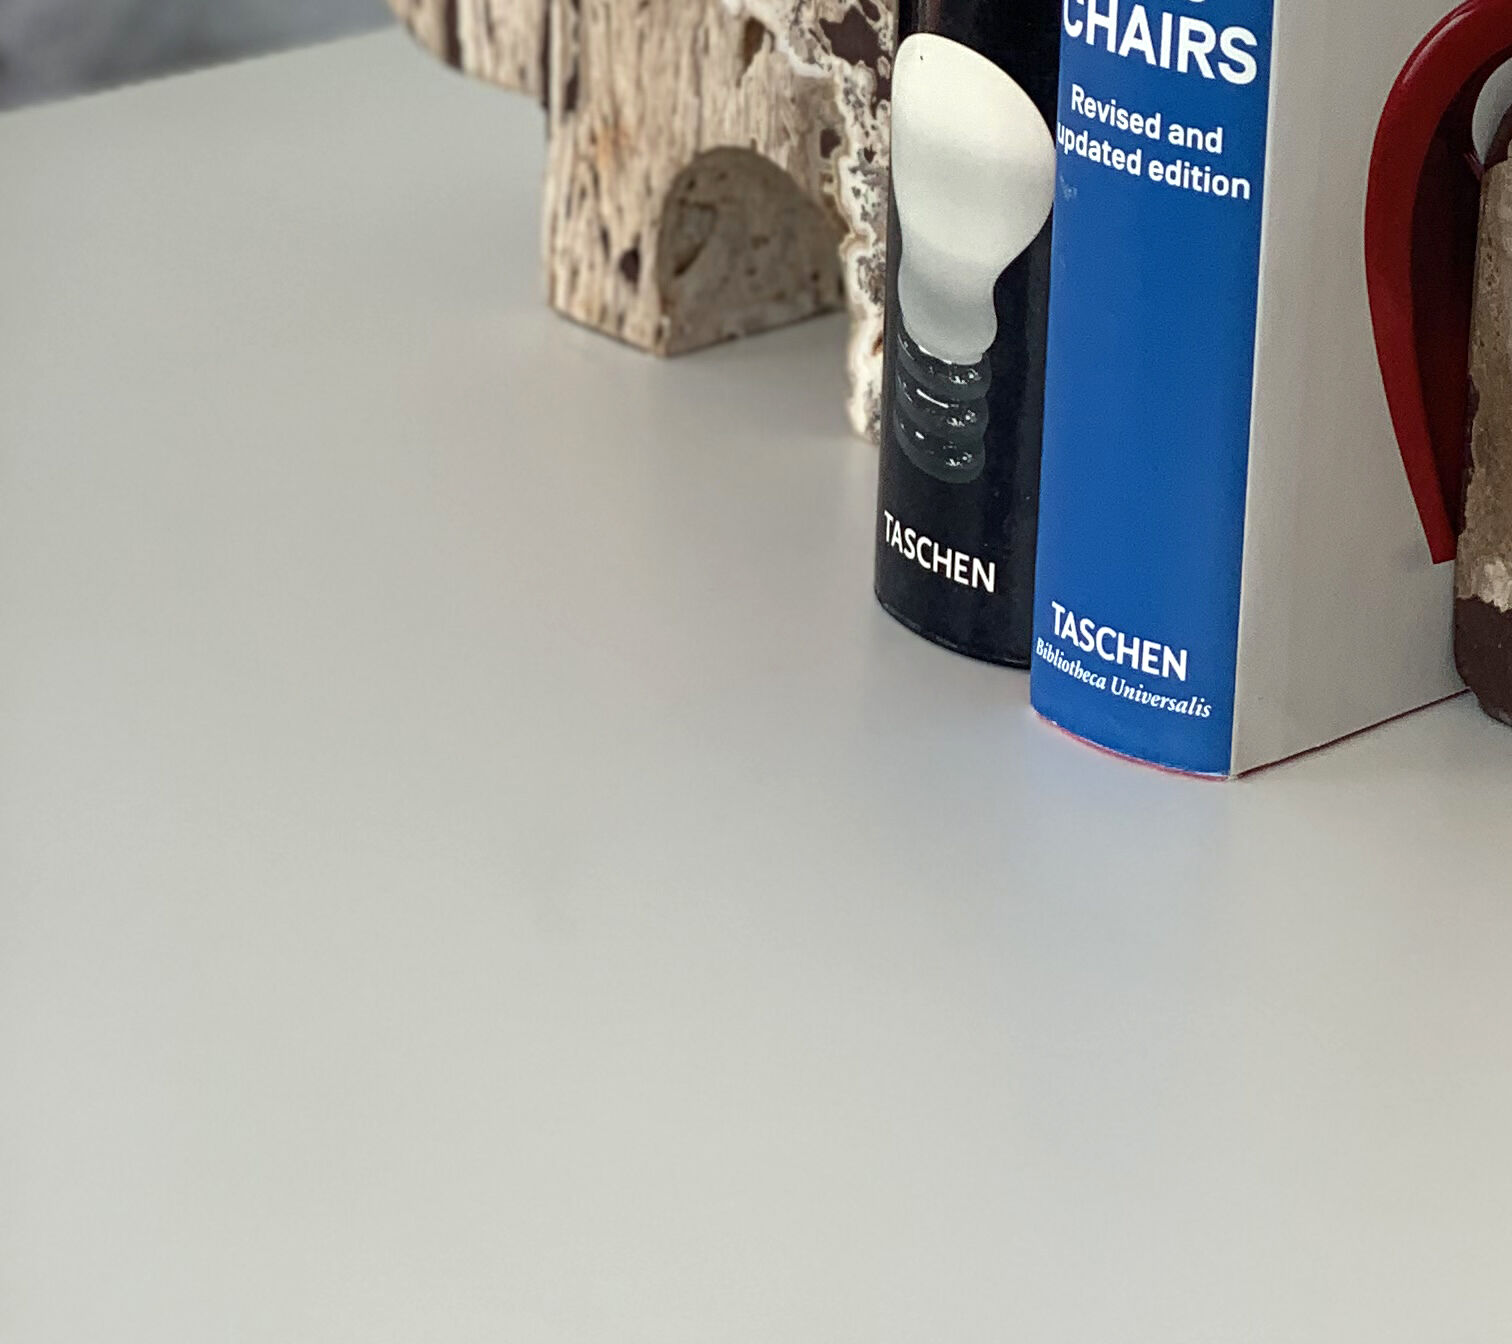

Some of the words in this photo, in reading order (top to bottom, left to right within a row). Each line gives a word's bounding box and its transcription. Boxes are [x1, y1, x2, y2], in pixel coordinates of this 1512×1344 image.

[1071, 83, 1161, 140] Revised
[1168, 124, 1223, 154] and
[1057, 122, 1142, 176] updated
[1148, 158, 1251, 200] edition
[884, 510, 996, 593] TASCHEN
[1035, 636, 1106, 690] Bibliotheca
[1111, 675, 1213, 718] Universalis
[1051, 600, 1188, 682] TASCHEN
